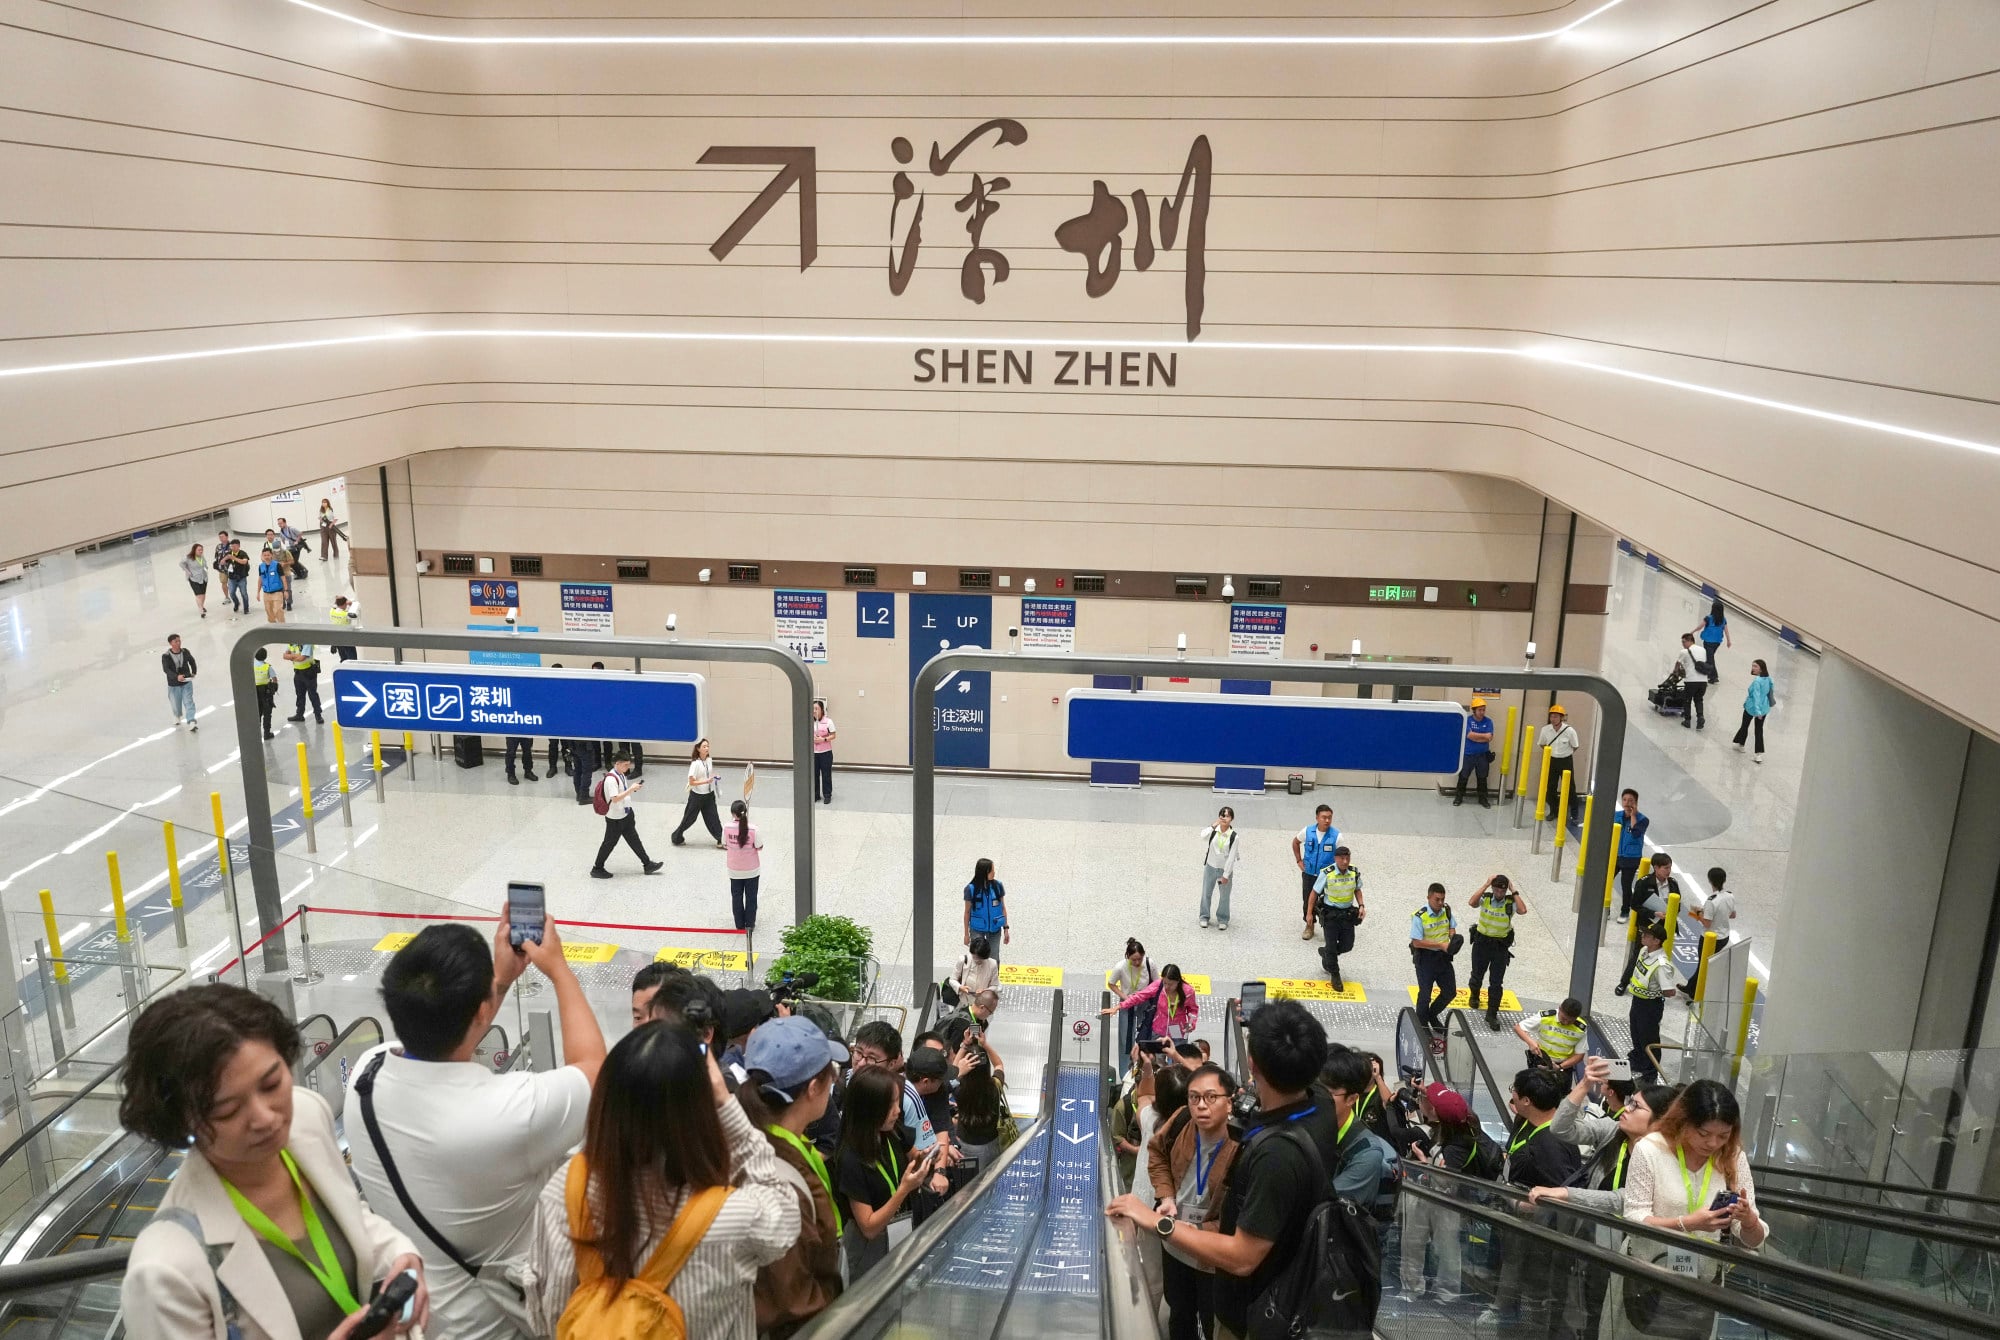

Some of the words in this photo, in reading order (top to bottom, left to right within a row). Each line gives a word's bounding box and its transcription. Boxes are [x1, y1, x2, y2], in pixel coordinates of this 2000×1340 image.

[889, 118, 1212, 343] 深圳
[913, 348, 1034, 384] SHEN
[1053, 350, 1178, 387] ZHEN
[1402, 590, 1416, 598] EXIT
[862, 607, 889, 624] L2
[921, 614, 937, 628] 上
[957, 616, 979, 628] UP
[387, 688, 416, 715] 深
[469, 686, 511, 708] 深圳
[470, 710, 542, 725] Shenzhen
[942, 709, 983, 723] 往深圳
[1061, 1098, 1094, 1112] L2
[1057, 1160, 1091, 1169] ZHEN
[1056, 1173, 1090, 1181] SHEN
[1675, 1255, 1691, 1263] 記者
[1672, 1264, 1694, 1272] MEDIA
